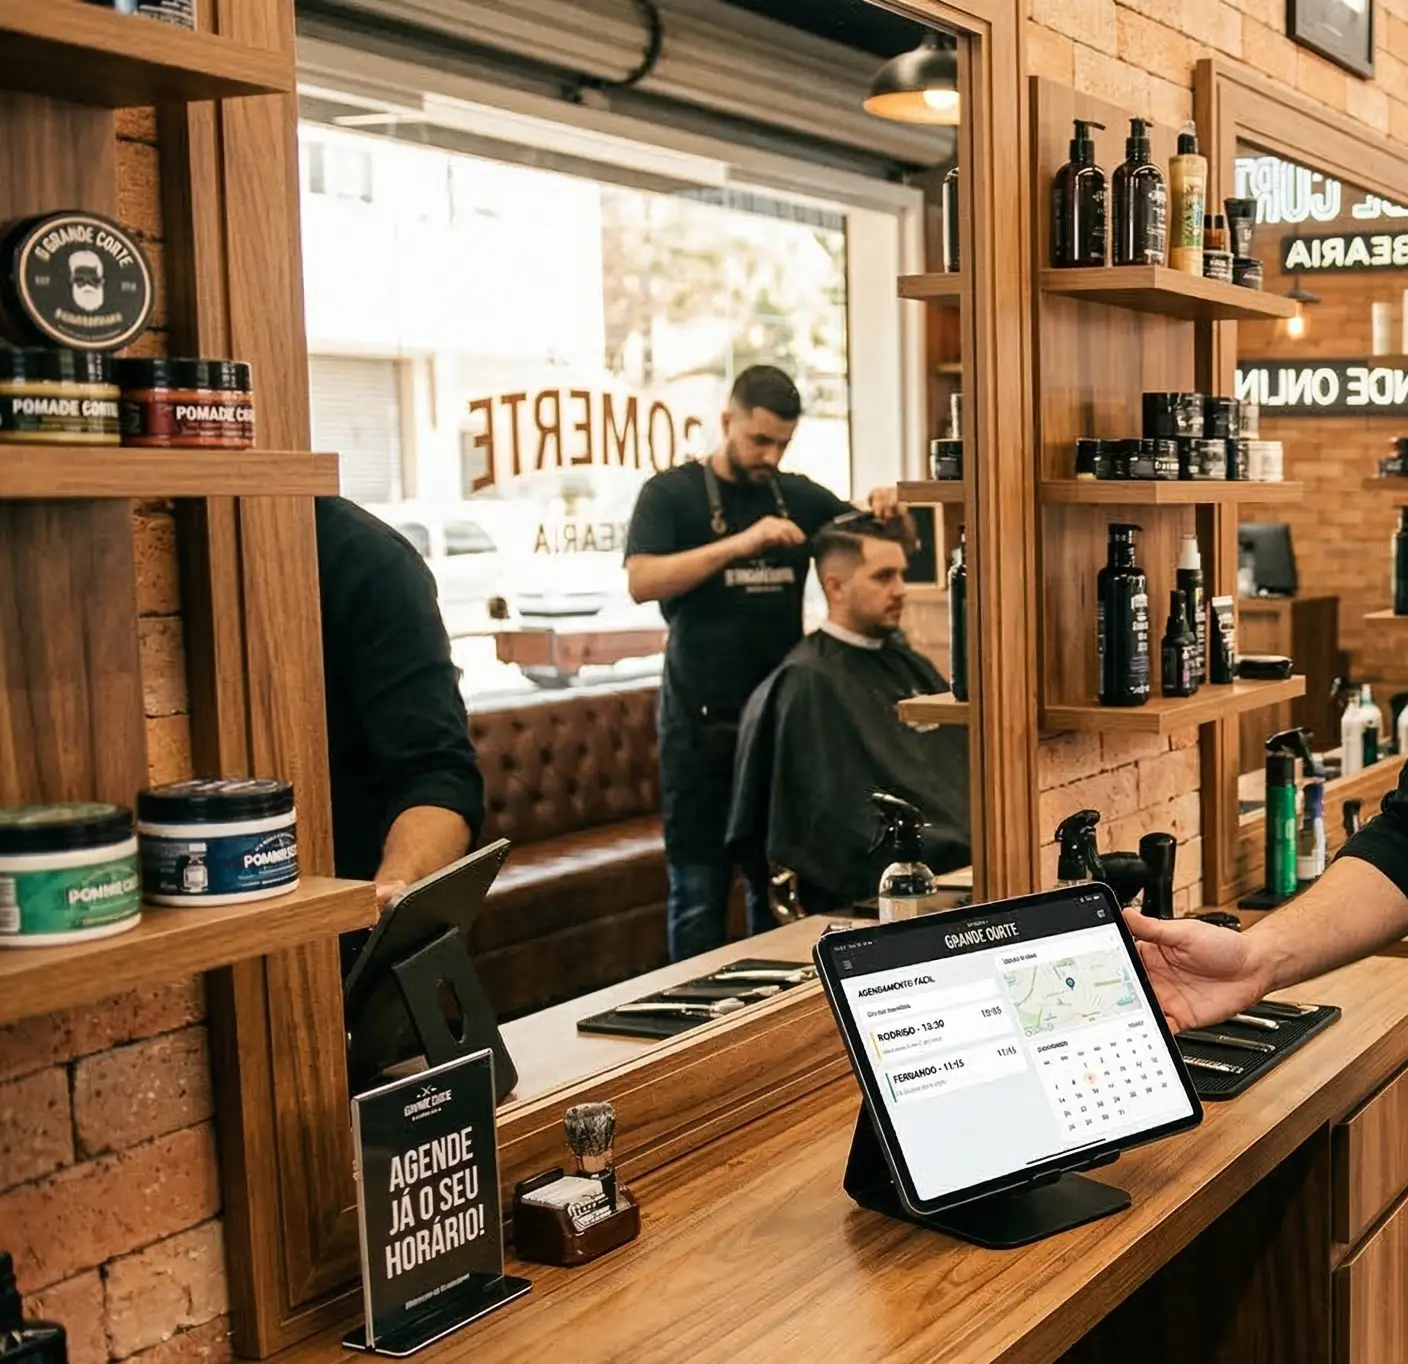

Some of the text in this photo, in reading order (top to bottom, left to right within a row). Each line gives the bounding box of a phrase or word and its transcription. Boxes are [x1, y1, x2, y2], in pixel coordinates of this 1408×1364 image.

[95, 230, 134, 268] CORTE
[13, 398, 80, 417] POMADE
[176, 405, 235, 422] POMADE
[389, 1126, 474, 1193] AGENDE
[389, 1165, 478, 1236] JÁ O SEU
[385, 1204, 485, 1280] HORÁRIO!
